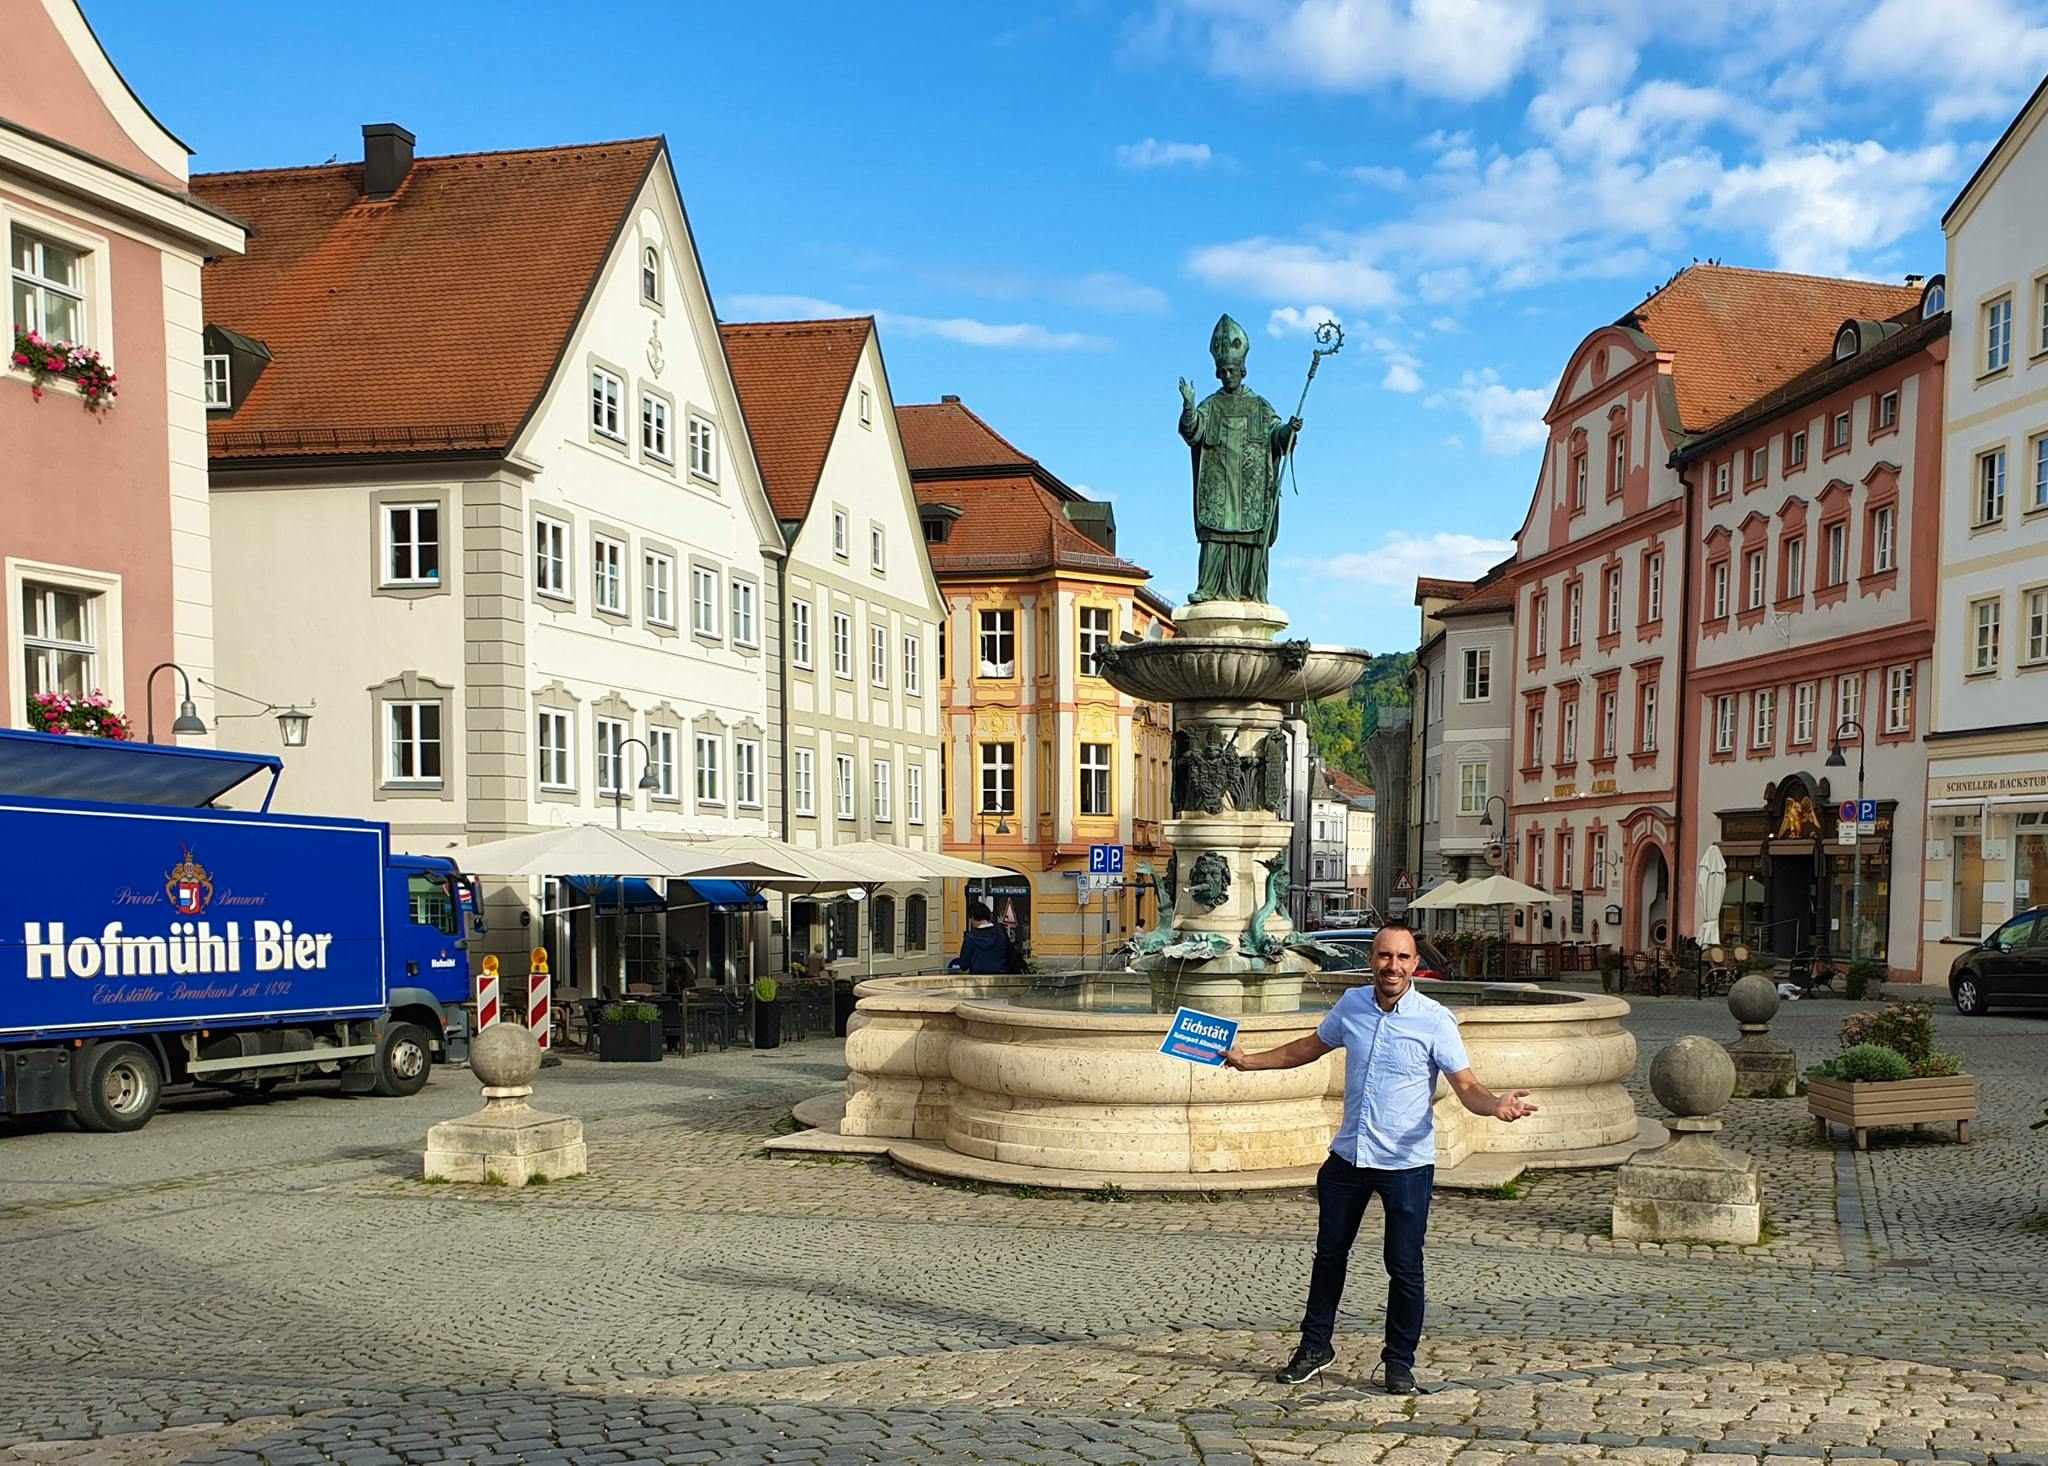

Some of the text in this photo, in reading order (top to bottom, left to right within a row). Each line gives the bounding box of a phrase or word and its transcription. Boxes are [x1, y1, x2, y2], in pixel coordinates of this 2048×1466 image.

[1946, 776, 2048, 792] SCHNELLERs BACKSTUB
[1861, 803, 1872, 819] P
[1093, 849, 1104, 870] P
[1111, 849, 1120, 870] P
[24, 919, 333, 979] Hofmühl Bier
[1180, 1017, 1228, 1041] Eichstätt
